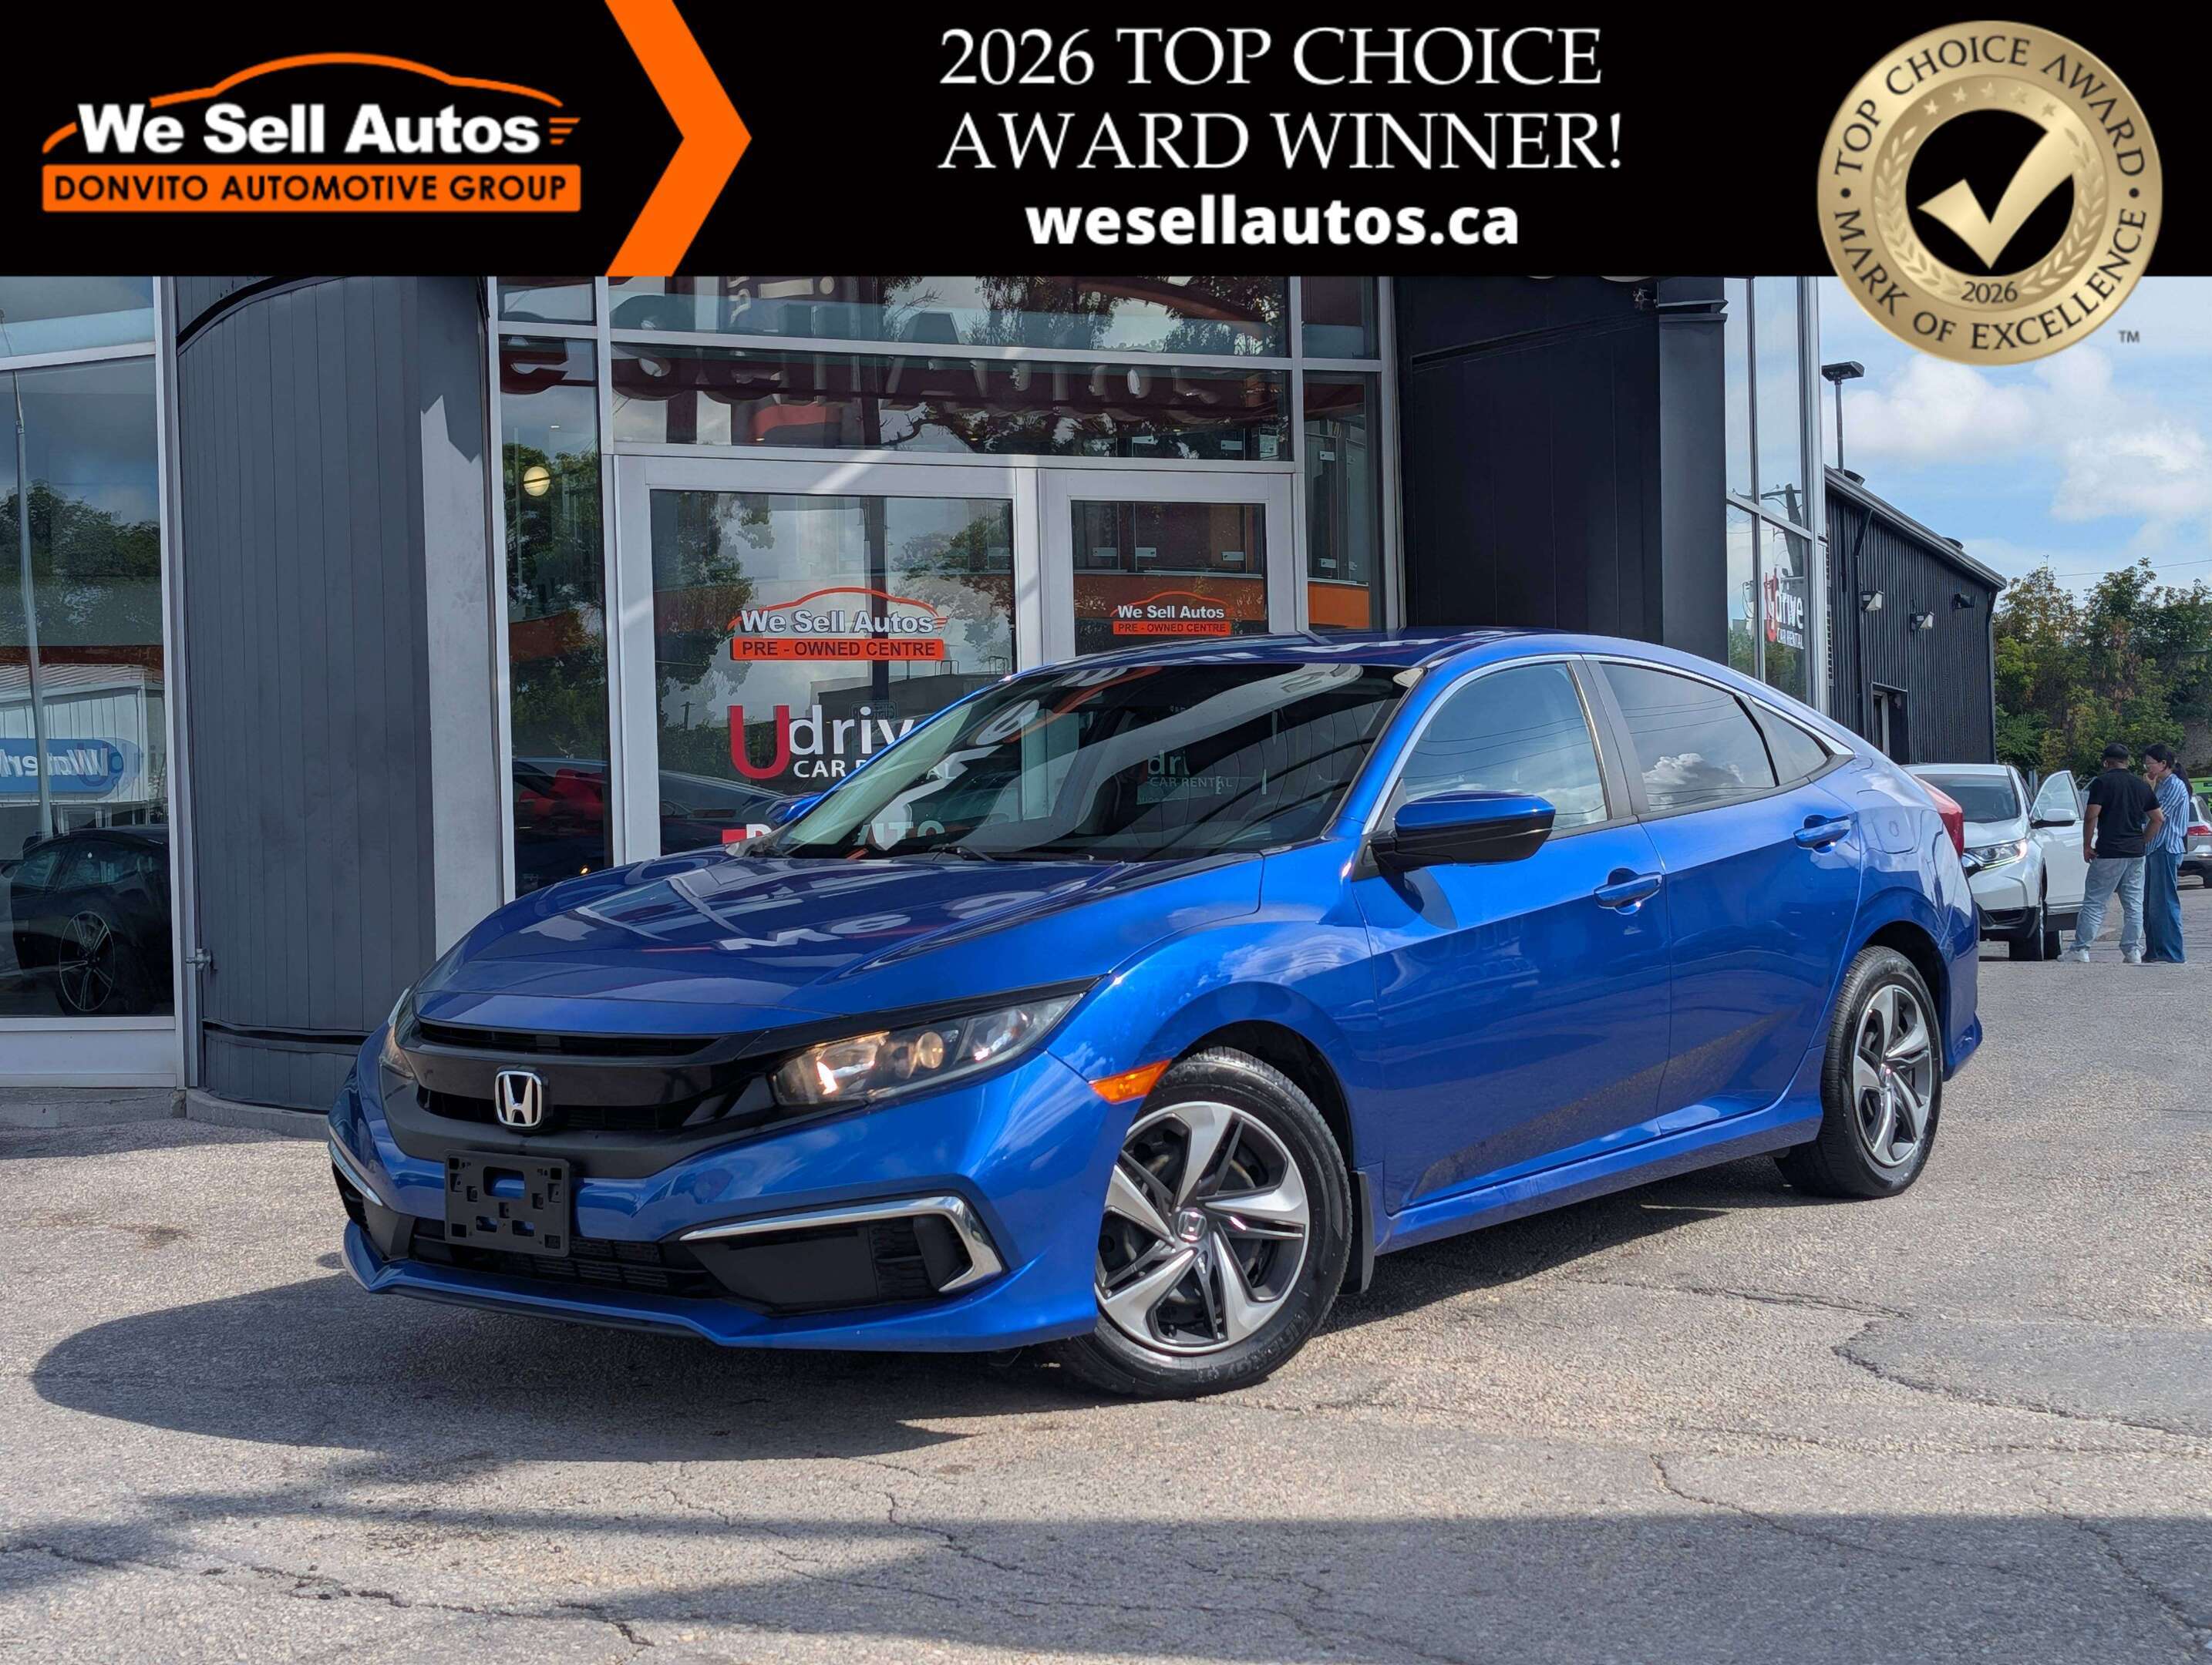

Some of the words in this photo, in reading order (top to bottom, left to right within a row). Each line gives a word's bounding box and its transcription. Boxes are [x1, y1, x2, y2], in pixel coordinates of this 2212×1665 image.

[1118, 605, 1142, 618] We
[1147, 605, 1175, 618] Sell
[1180, 605, 1224, 618] Autos
[740, 610, 786, 633] We
[790, 610, 845, 633] Sell
[851, 610, 934, 633] Autos
[1118, 623, 1140, 632] PRE
[1147, 623, 1183, 632] OWNED
[1187, 623, 1226, 632] CENTRE
[742, 641, 778, 656] PRE
[794, 641, 860, 656] OWNED
[866, 641, 935, 656] CENTRE
[727, 705, 915, 779] Udriv
[793, 760, 846, 778] CAR
[1149, 777, 1179, 788] CAR
